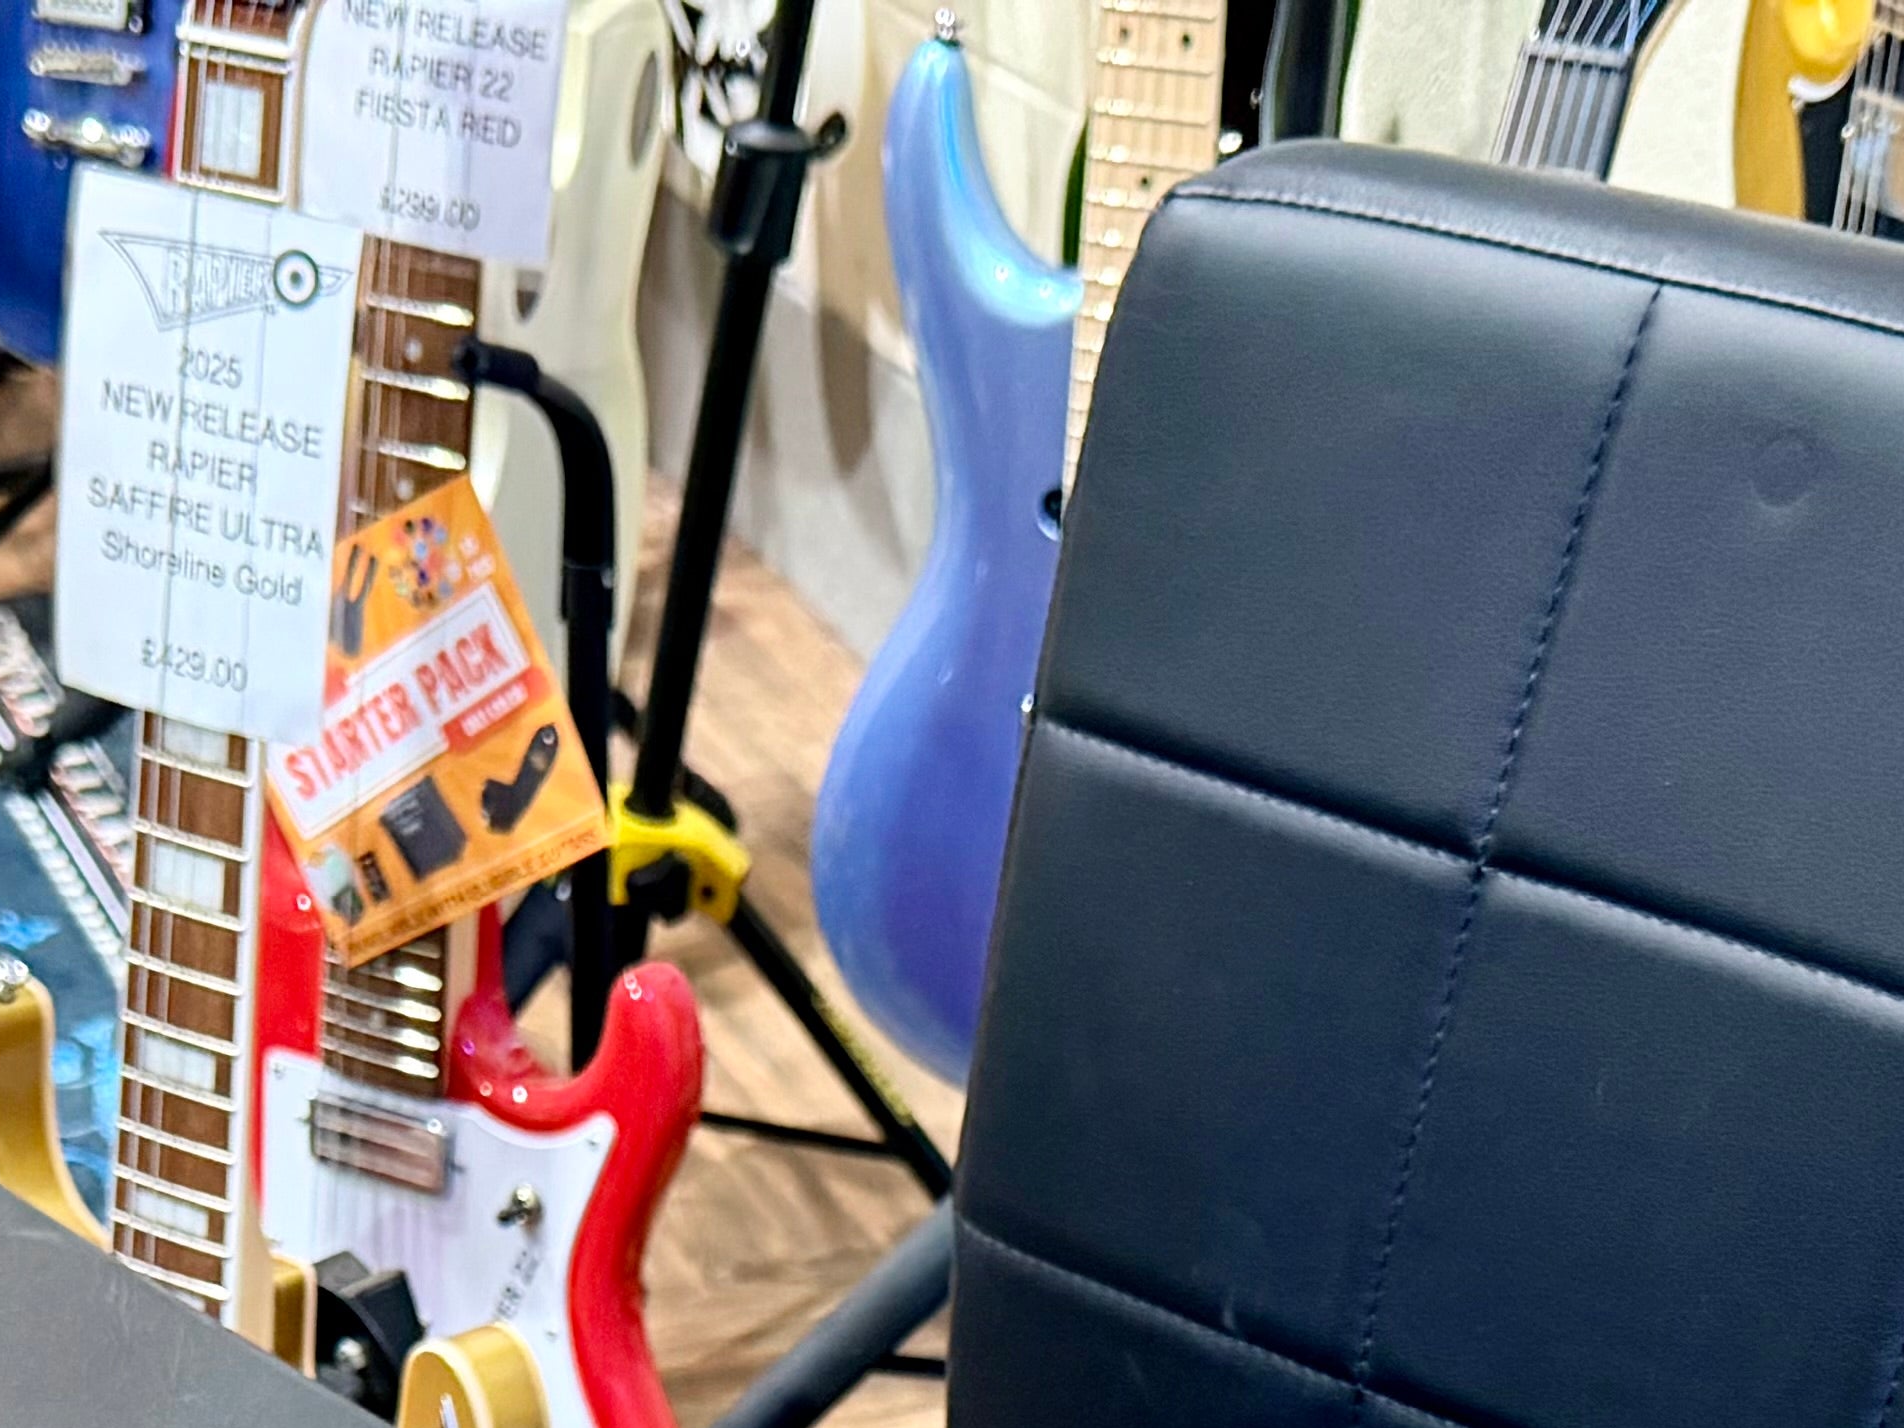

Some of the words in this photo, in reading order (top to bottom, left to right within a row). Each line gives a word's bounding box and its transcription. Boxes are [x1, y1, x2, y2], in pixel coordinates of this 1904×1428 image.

[414, 8, 550, 62] RELEASE
[368, 47, 473, 93] RAPIER
[479, 69, 516, 103] 22
[354, 89, 452, 136] FIESTA
[458, 110, 523, 149] RED
[179, 346, 243, 390] 2025
[101, 378, 175, 425] NEW
[180, 397, 325, 459] RELEASE
[148, 440, 258, 495] RAPIER
[87, 477, 212, 536] SAFFRE
[220, 507, 325, 558] ULTRA
[101, 529, 227, 589] Shoreline
[234, 564, 303, 606] Gold
[283, 683, 421, 800] STARTER
[415, 622, 508, 717] PACK
